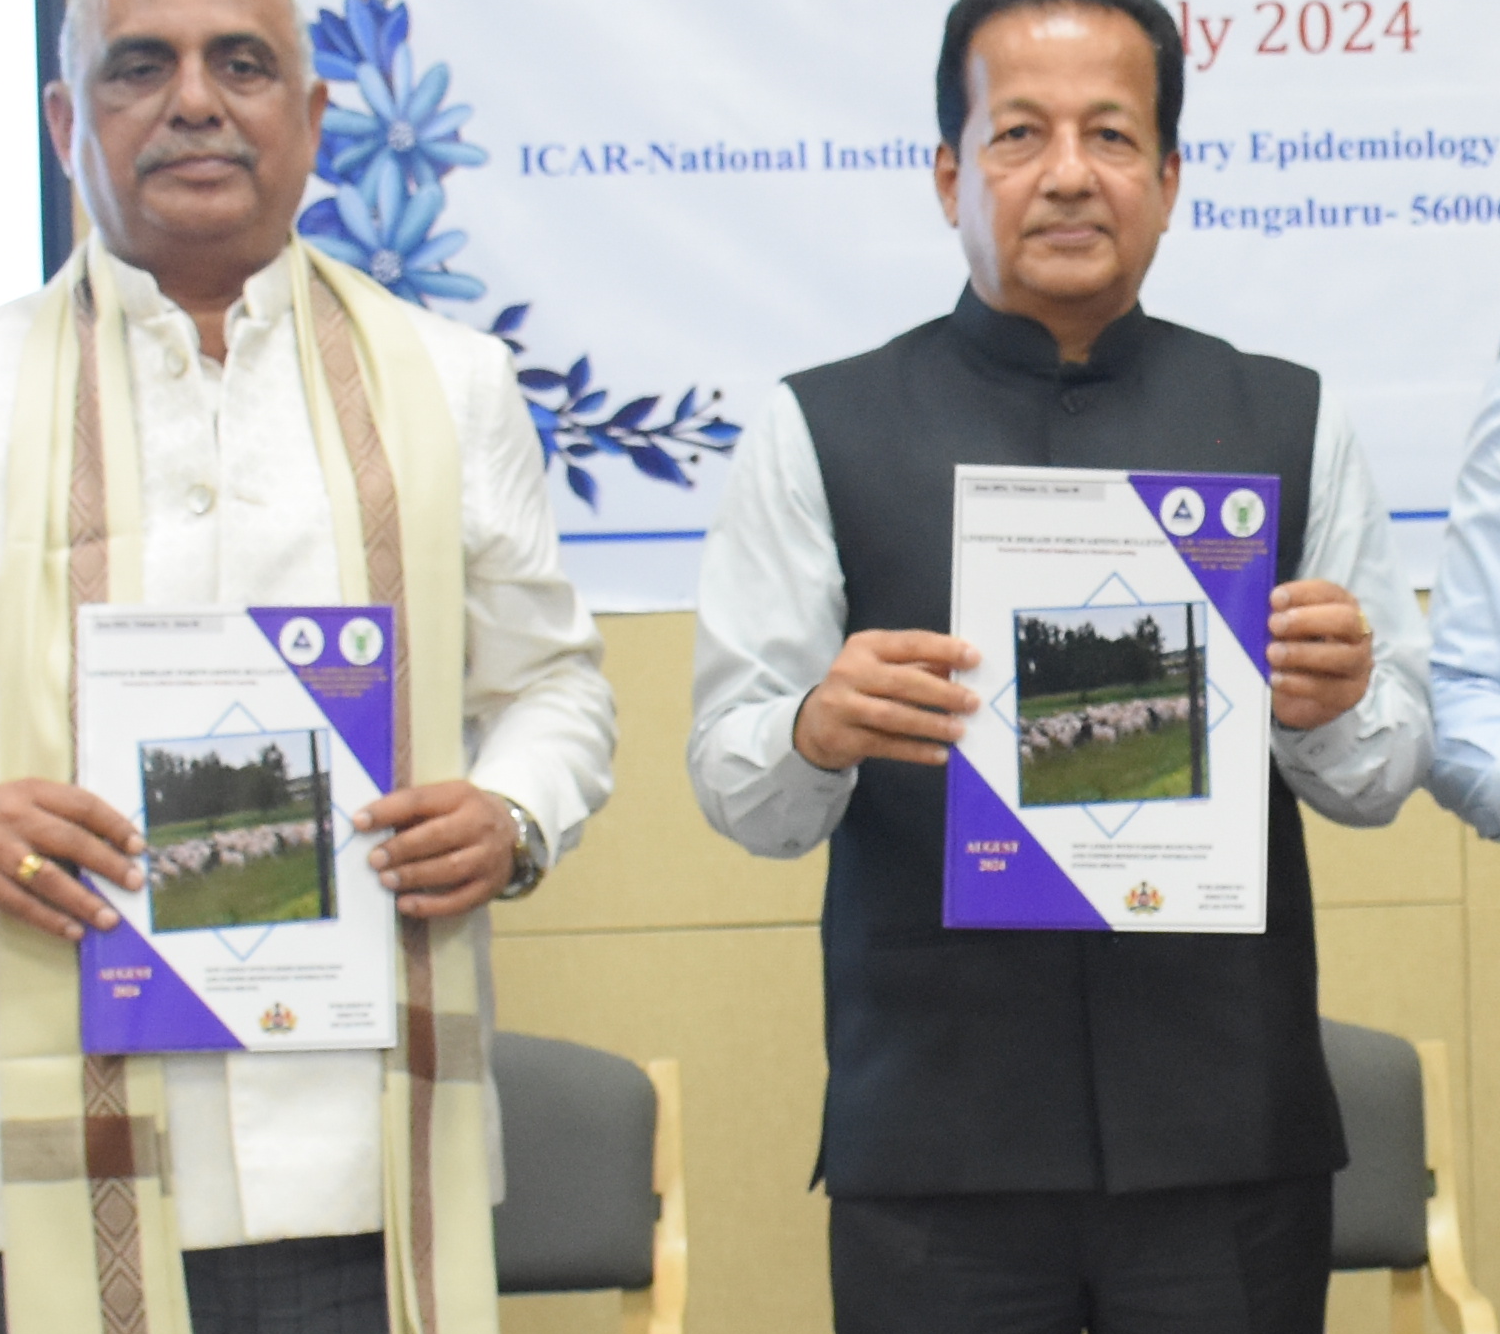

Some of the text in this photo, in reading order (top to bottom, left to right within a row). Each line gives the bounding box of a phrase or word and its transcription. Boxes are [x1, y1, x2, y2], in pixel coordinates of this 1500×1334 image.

[1178, 0, 1422, 72] ly 2024
[519, 139, 807, 178] ICAR-National
[821, 137, 935, 170] Institu
[1249, 128, 1500, 168] Epidemiology
[1190, 197, 1398, 238] Bengaluru-
